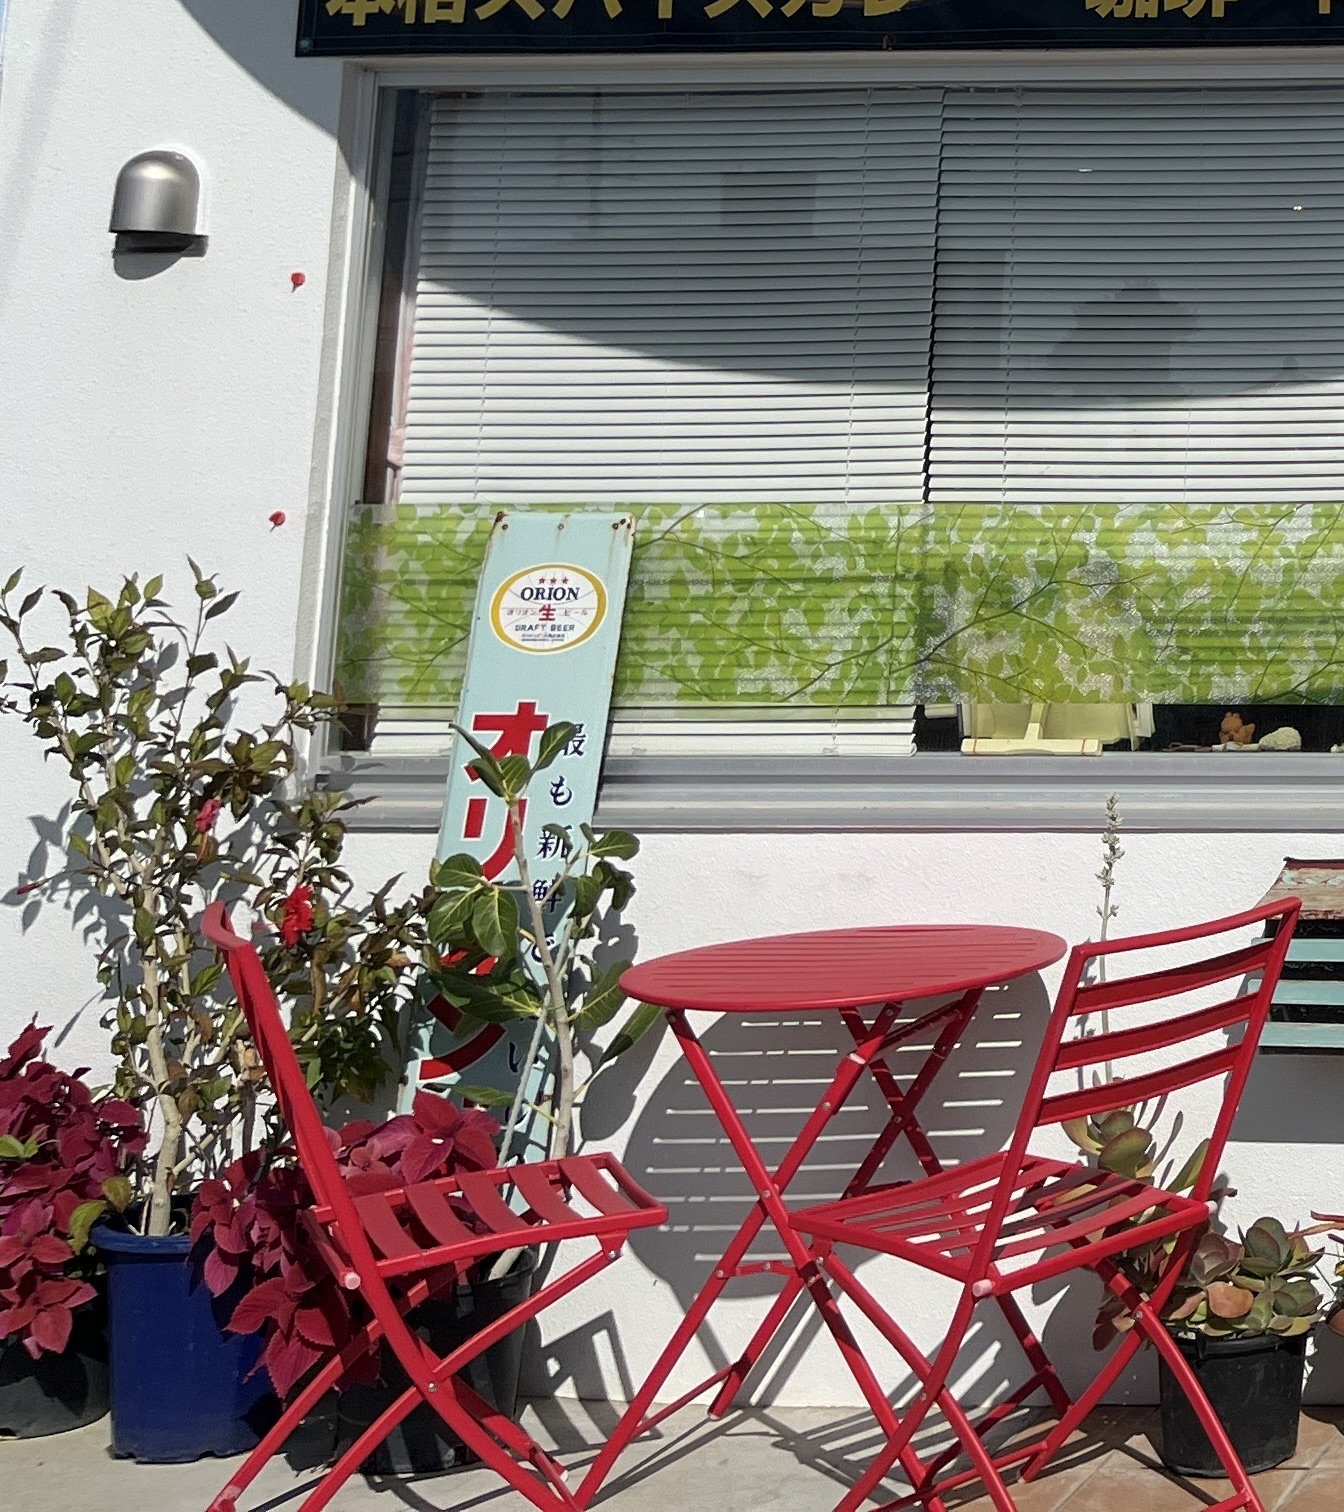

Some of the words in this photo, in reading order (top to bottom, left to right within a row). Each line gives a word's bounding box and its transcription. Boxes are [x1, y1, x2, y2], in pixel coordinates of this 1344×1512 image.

[520, 587, 580, 601] ORION
[538, 603, 557, 621] 生
[514, 623, 547, 631] DRAFT
